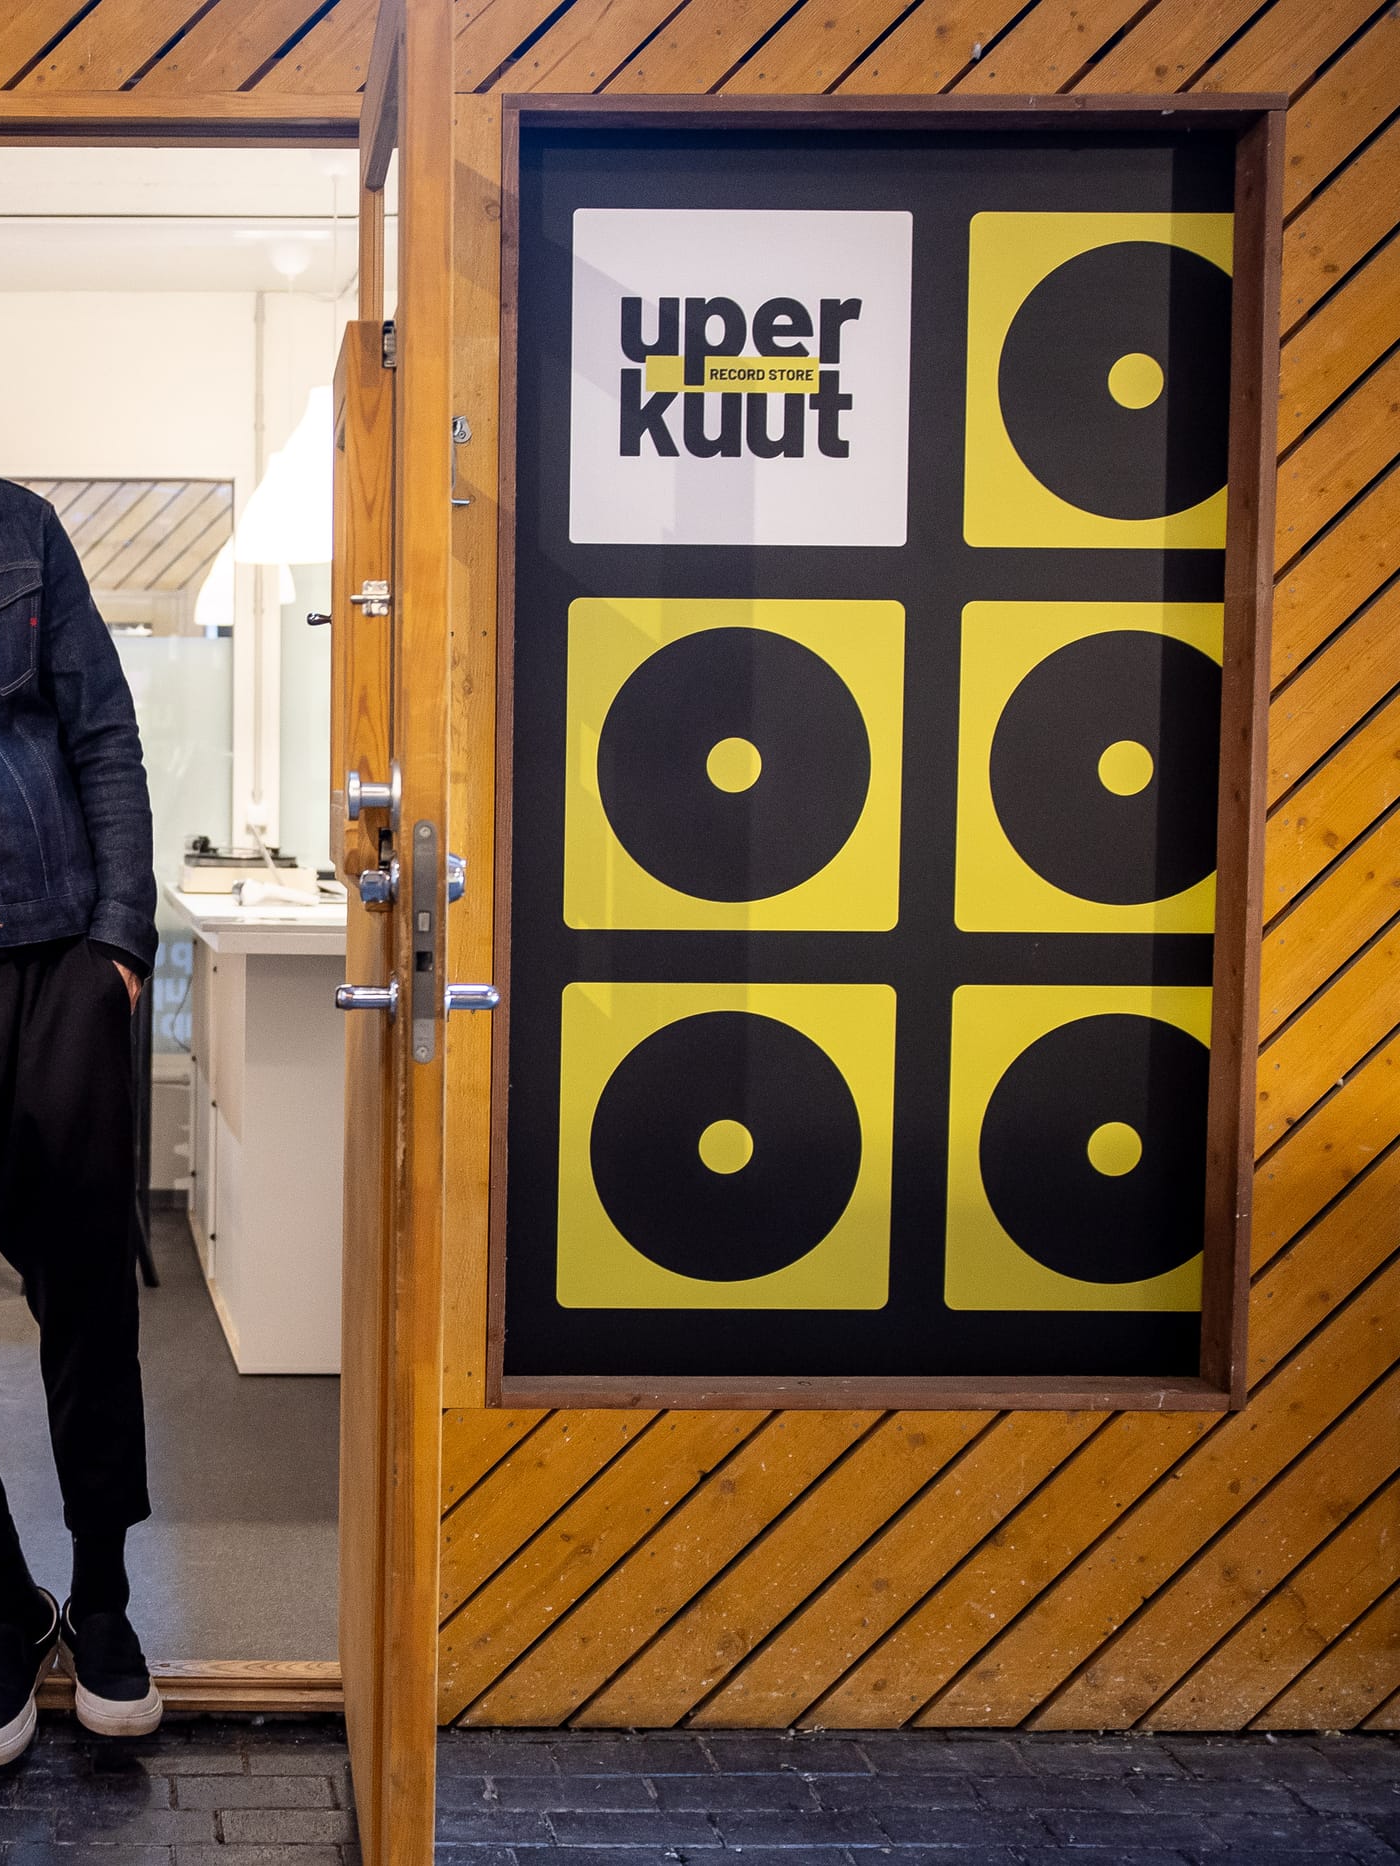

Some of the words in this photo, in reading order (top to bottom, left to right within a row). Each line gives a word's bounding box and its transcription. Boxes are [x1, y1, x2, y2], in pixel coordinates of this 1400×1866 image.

[620, 296, 863, 386] uper
[709, 368, 765, 381] RECORD
[768, 369, 814, 381] STORE
[619, 368, 853, 459] kuut
